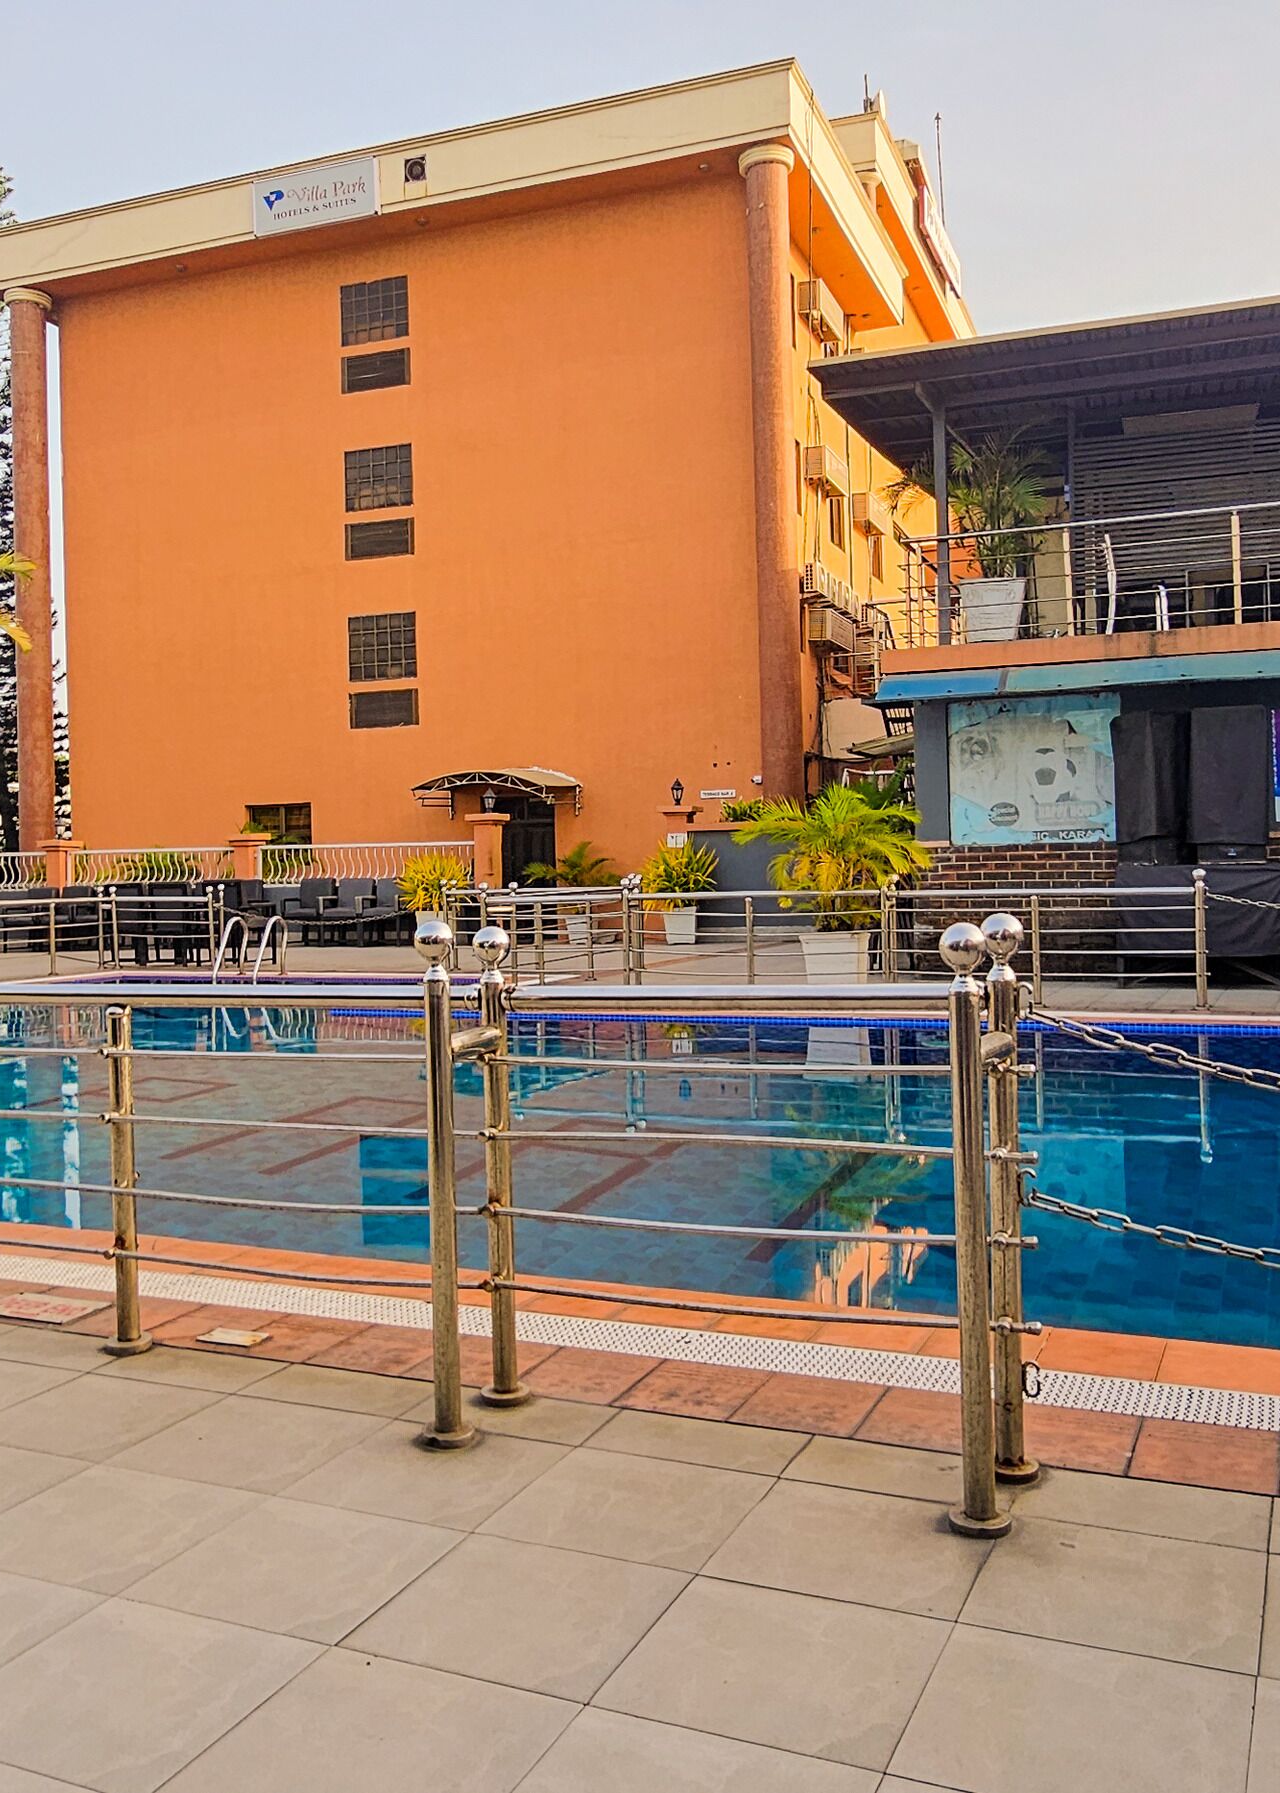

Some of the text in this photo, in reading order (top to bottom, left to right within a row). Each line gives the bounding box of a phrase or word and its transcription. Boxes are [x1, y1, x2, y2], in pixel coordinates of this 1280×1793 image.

[287, 176, 367, 202] Villa Park
[273, 197, 357, 220] HOTELS & SUITES
